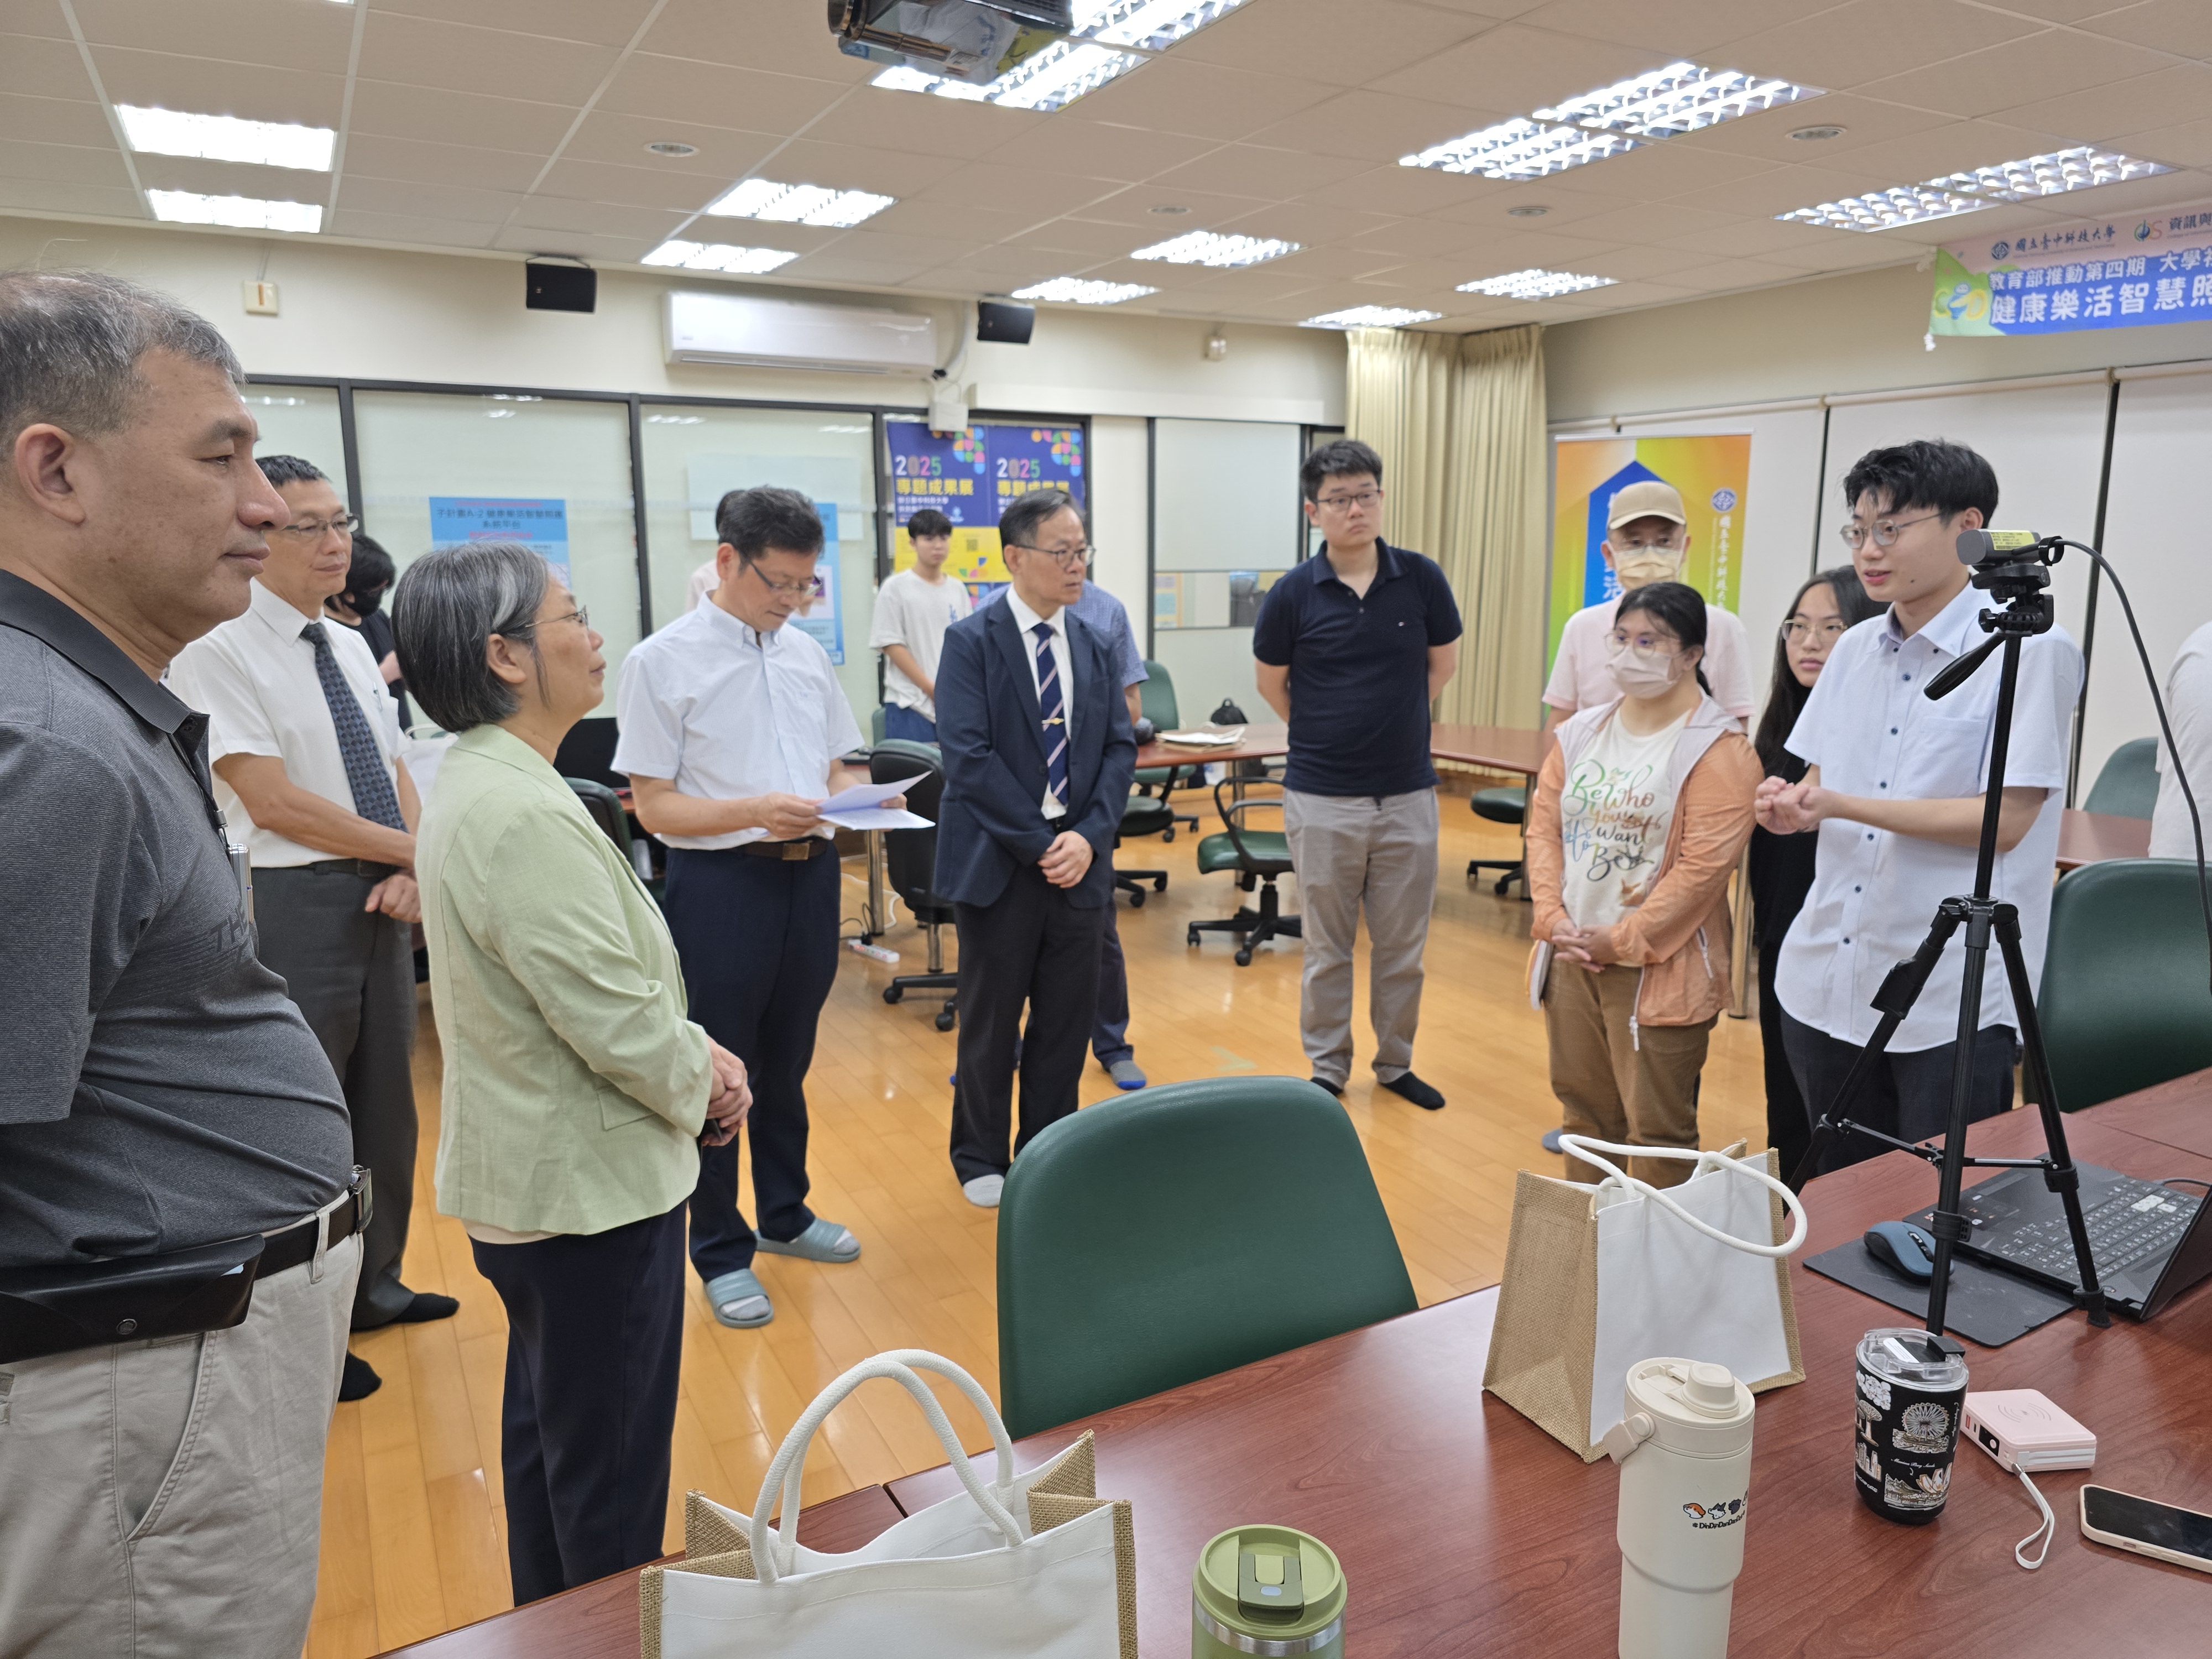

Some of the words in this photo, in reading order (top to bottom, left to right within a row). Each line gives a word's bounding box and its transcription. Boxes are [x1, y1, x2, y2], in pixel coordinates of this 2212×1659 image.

[1990, 257, 2146, 290] 教育部推動第四期
[1991, 273, 2212, 324] 健康樂活智慧照
[895, 455, 941, 476] 2025
[997, 457, 1041, 478] 2025
[1563, 759, 1606, 816] Be
